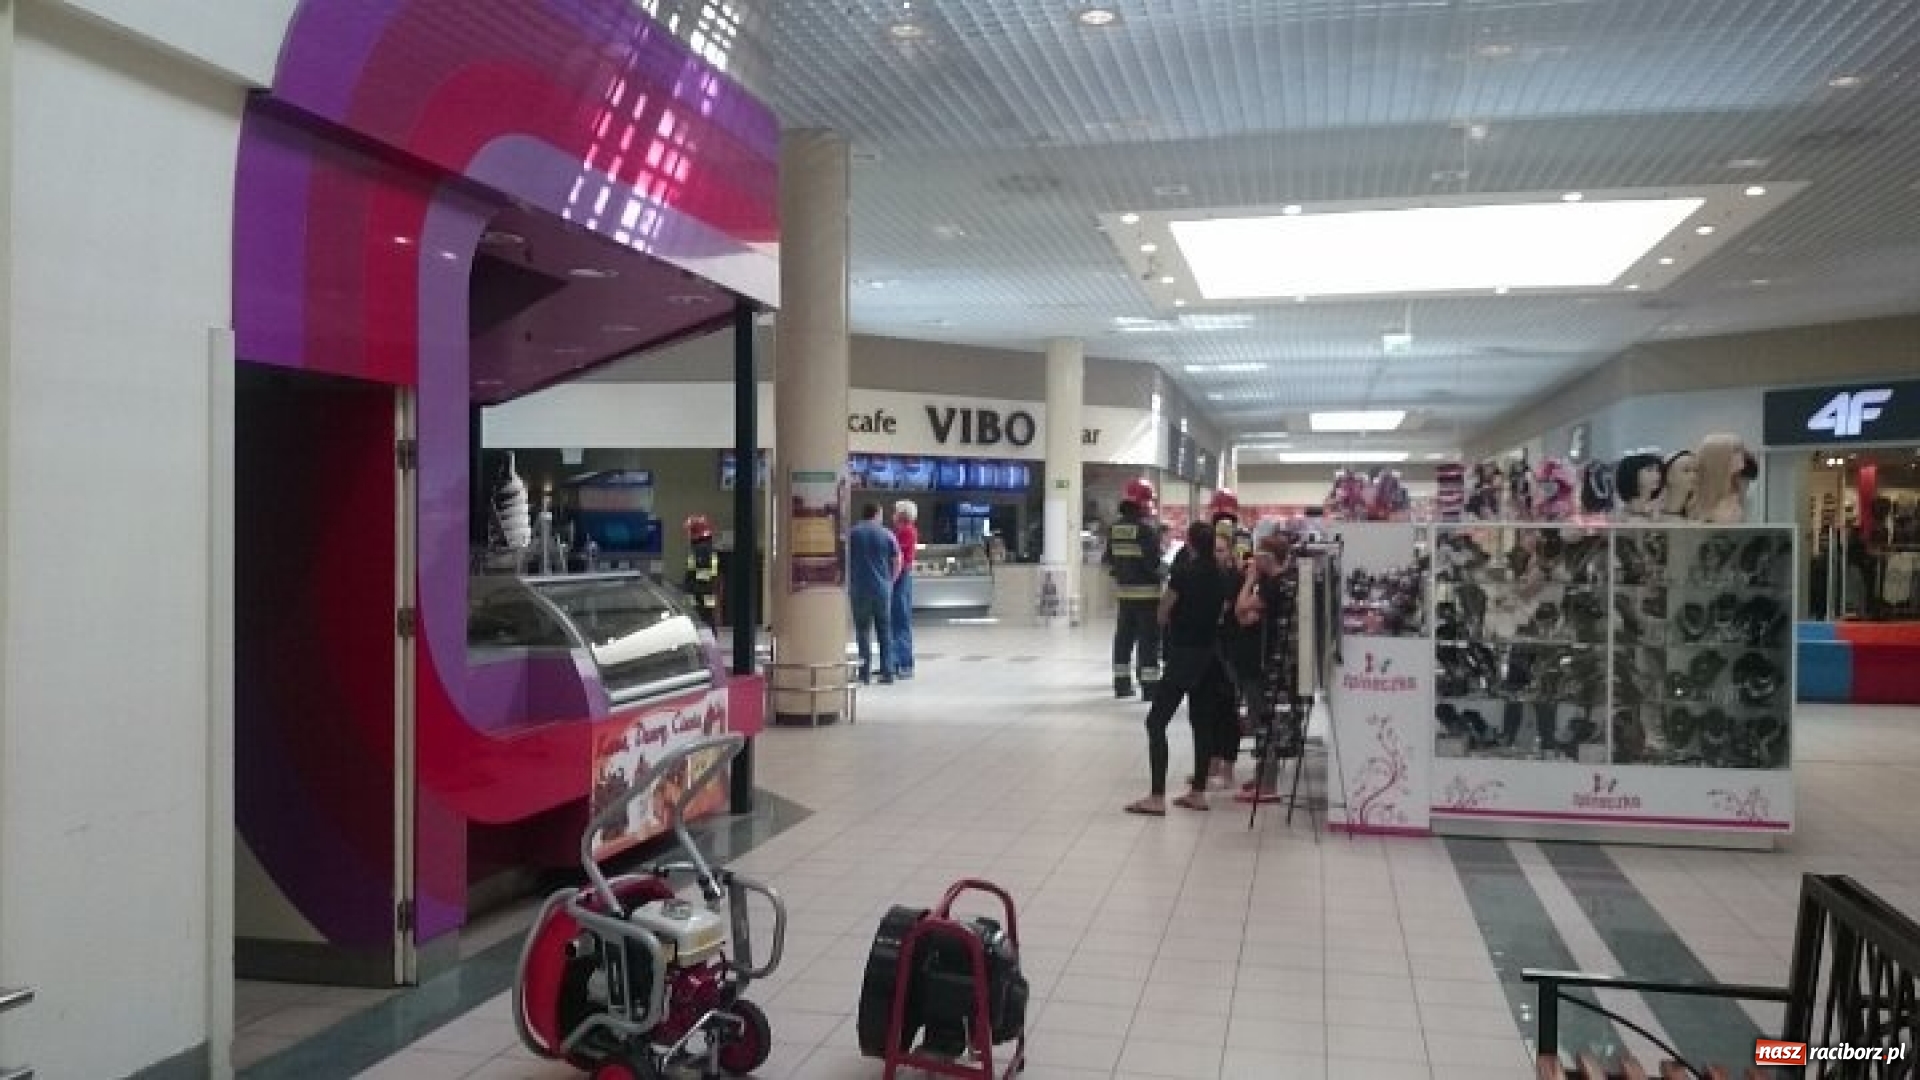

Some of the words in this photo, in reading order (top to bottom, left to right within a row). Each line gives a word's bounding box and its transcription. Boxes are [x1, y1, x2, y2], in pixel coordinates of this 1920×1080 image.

[848, 410, 897, 434] cafe
[925, 405, 1036, 447] VIBO
[1081, 428, 1102, 445] ar
[1807, 388, 1893, 436] 4F
